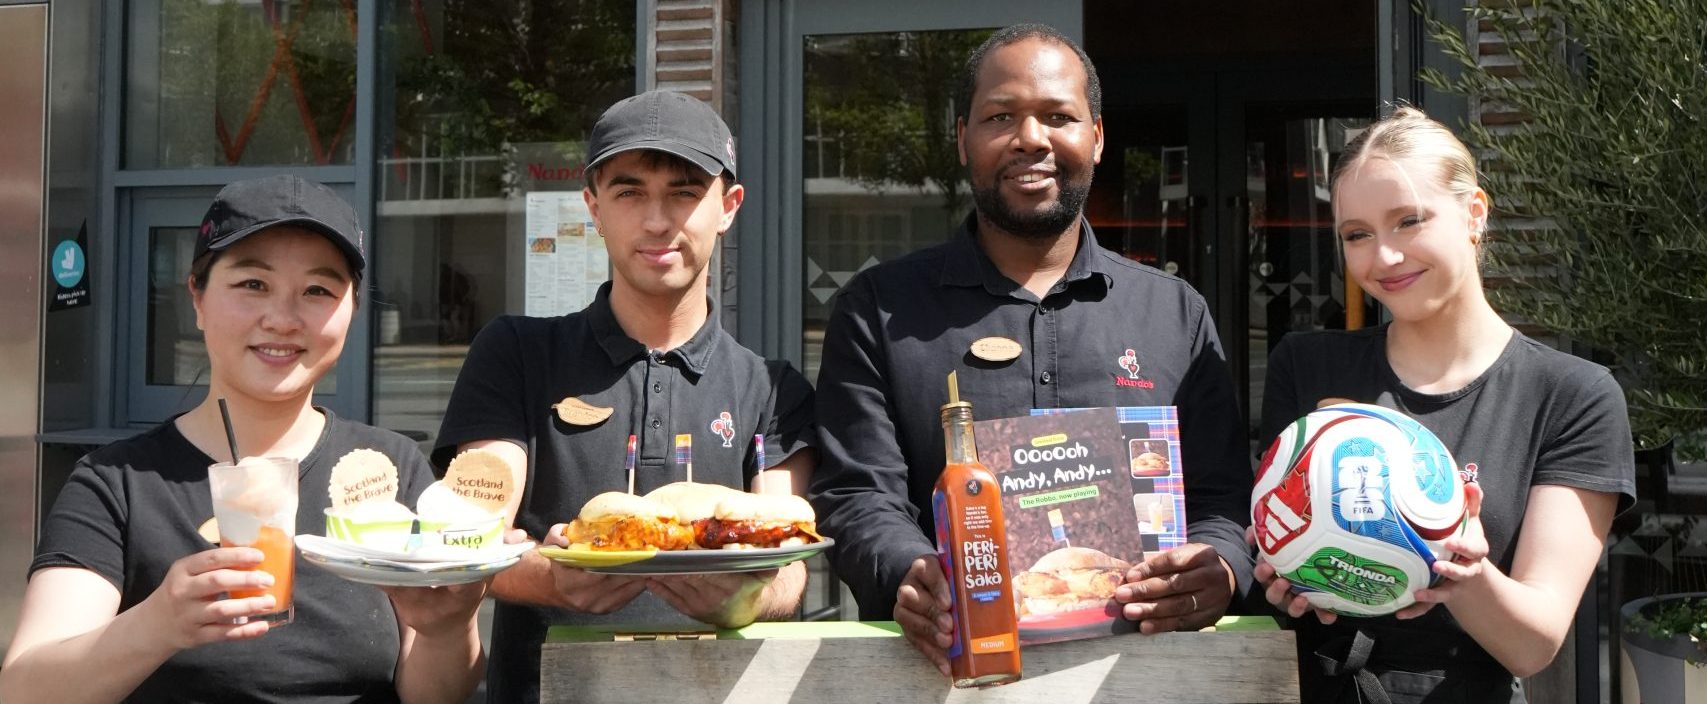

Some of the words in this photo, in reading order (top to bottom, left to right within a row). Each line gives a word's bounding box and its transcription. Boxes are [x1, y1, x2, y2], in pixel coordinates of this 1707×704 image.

[528, 163, 585, 181] Nand
[344, 472, 387, 495] Scotland
[456, 477, 503, 490] Scotland
[1002, 471, 1051, 493] Andy,
[1054, 464, 1111, 484] Andy...
[344, 494, 361, 505] the
[364, 483, 393, 499] Brave
[473, 489, 504, 501] Brave
[1073, 488, 1097, 498] playing
[1353, 506, 1374, 514] FIFA
[443, 535, 482, 549] Extra
[1329, 555, 1396, 584] TRIONDA
[965, 571, 1002, 589] Saka
